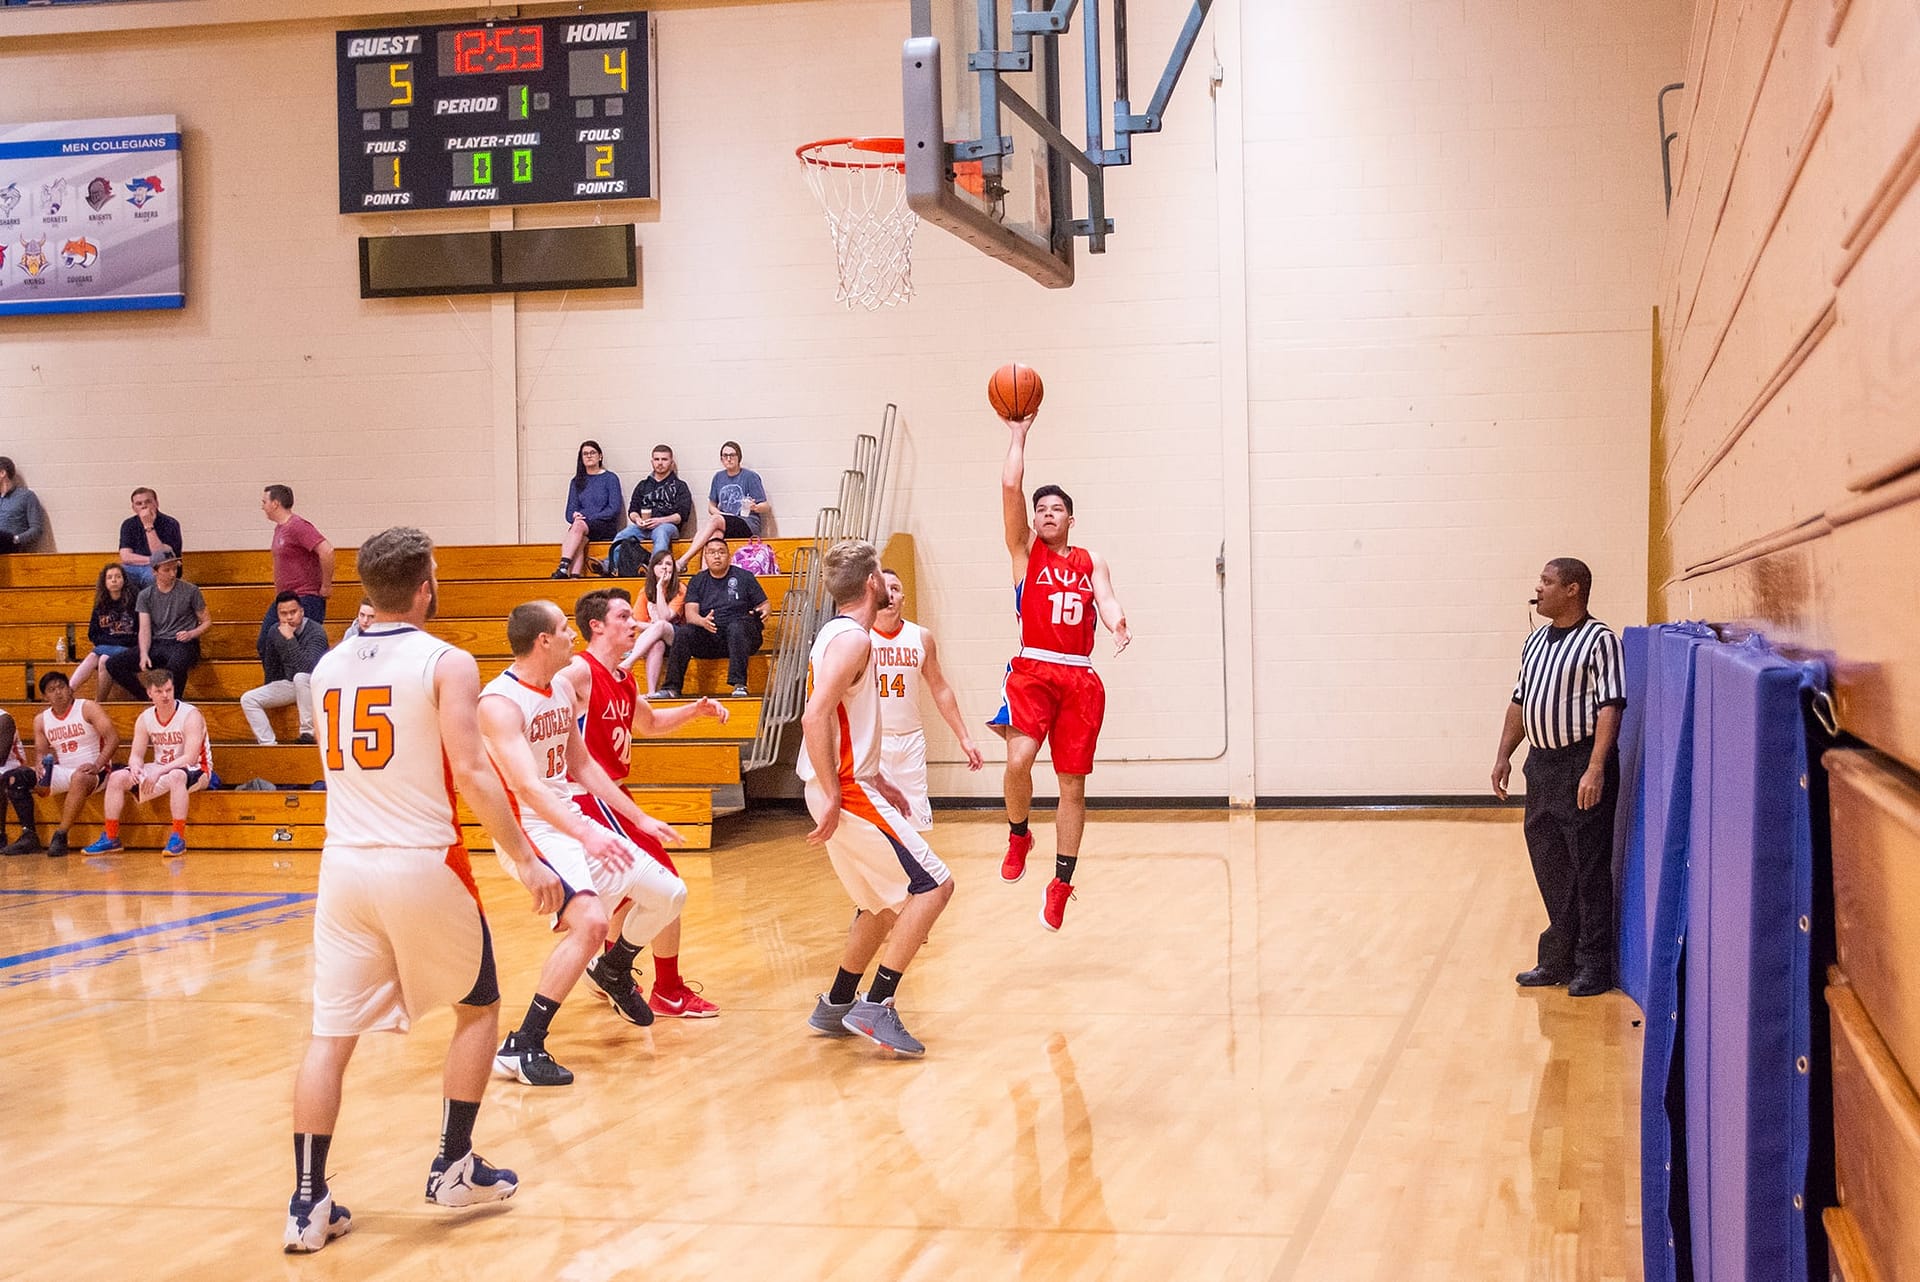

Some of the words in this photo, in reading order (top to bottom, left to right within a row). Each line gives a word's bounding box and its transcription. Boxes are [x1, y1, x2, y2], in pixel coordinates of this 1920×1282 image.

[566, 22, 630, 43] HOME
[350, 35, 418, 57] GUEST
[454, 25, 543, 73] 12:53
[603, 49, 627, 91] 4
[390, 63, 412, 105] 5
[436, 97, 498, 115] PERIOD
[521, 86, 528, 119] 1
[62, 143, 89, 153] MEN
[92, 138, 166, 151] COLLEGIANS
[447, 133, 537, 150] PLAYER-FOUL
[579, 128, 620, 142] FOULS
[366, 140, 407, 153] FOULS
[473, 152, 491, 184] 0
[513, 149, 532, 182] 0
[595, 145, 613, 177] 2
[393, 157, 400, 188] 1
[364, 193, 410, 205] POINTS
[449, 188, 496, 202] MATCH
[577, 181, 624, 195] POINTS
[134, 211, 158, 219] RAIDERS
[1036, 566, 1093, 592] ΔΨΔ
[1048, 591, 1083, 625] 15
[872, 647, 919, 668] OUGARS
[880, 673, 905, 697] 14
[47, 723, 86, 742] COUGARS
[323, 685, 395, 771] 15
[546, 743, 565, 779] 13
